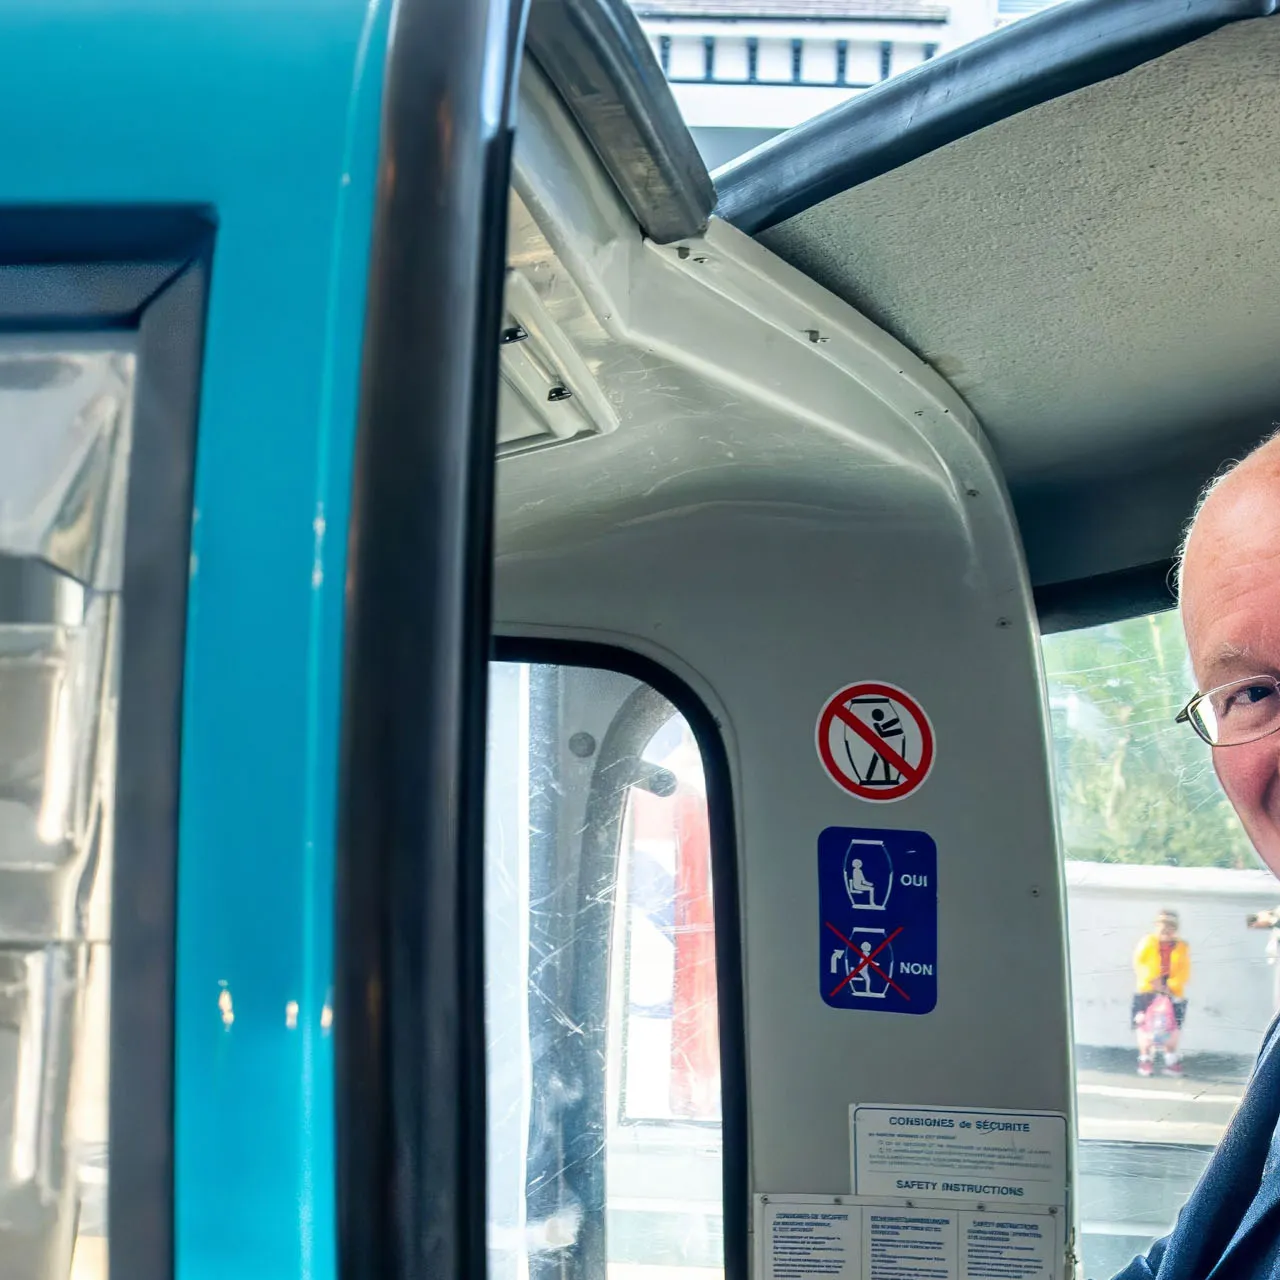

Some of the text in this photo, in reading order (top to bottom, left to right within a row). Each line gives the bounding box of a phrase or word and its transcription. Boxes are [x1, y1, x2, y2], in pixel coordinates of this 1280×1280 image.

[900, 873, 928, 888] OUI
[899, 961, 933, 976] NON
[889, 1116, 955, 1128] CONSIGNES
[959, 1120, 972, 1129] de
[896, 1179, 1024, 1196] SAFETY INSTRUCTIONS
